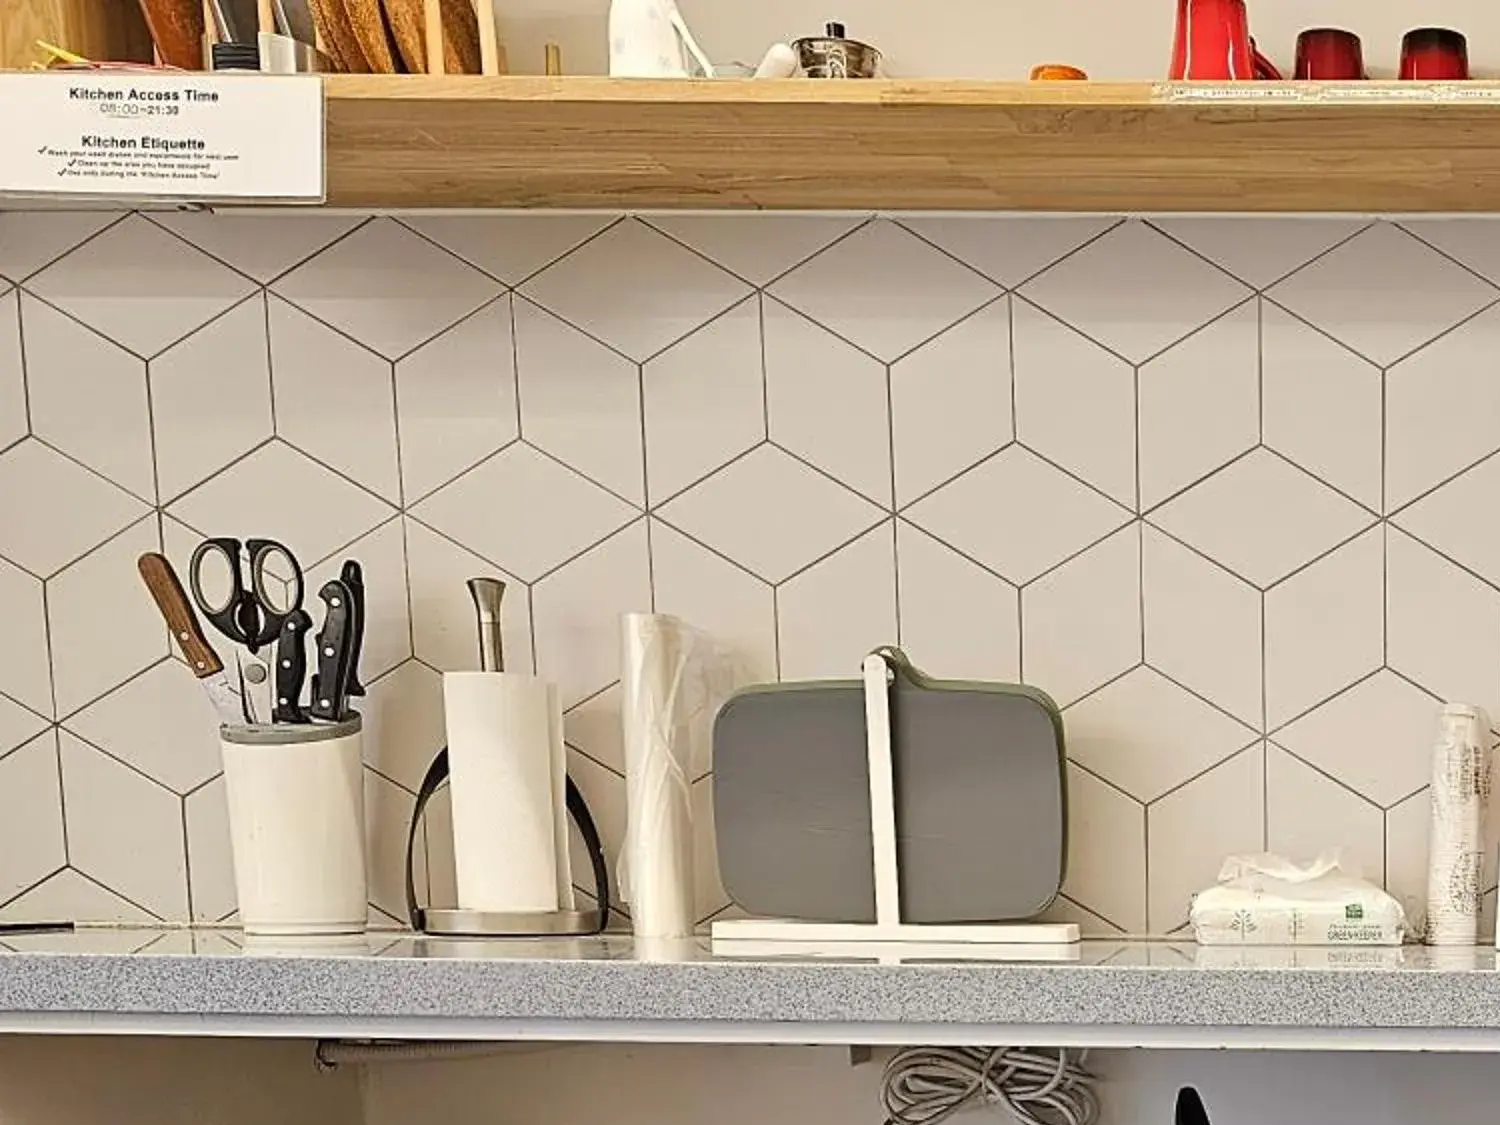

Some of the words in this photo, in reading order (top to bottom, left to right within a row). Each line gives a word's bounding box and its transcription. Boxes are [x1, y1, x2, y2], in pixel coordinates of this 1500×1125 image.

[69, 87, 123, 100] Kitchen
[127, 88, 179, 101] Access
[183, 89, 219, 102] Time
[81, 136, 136, 149] Kitchen
[141, 136, 205, 151] Etiquette
